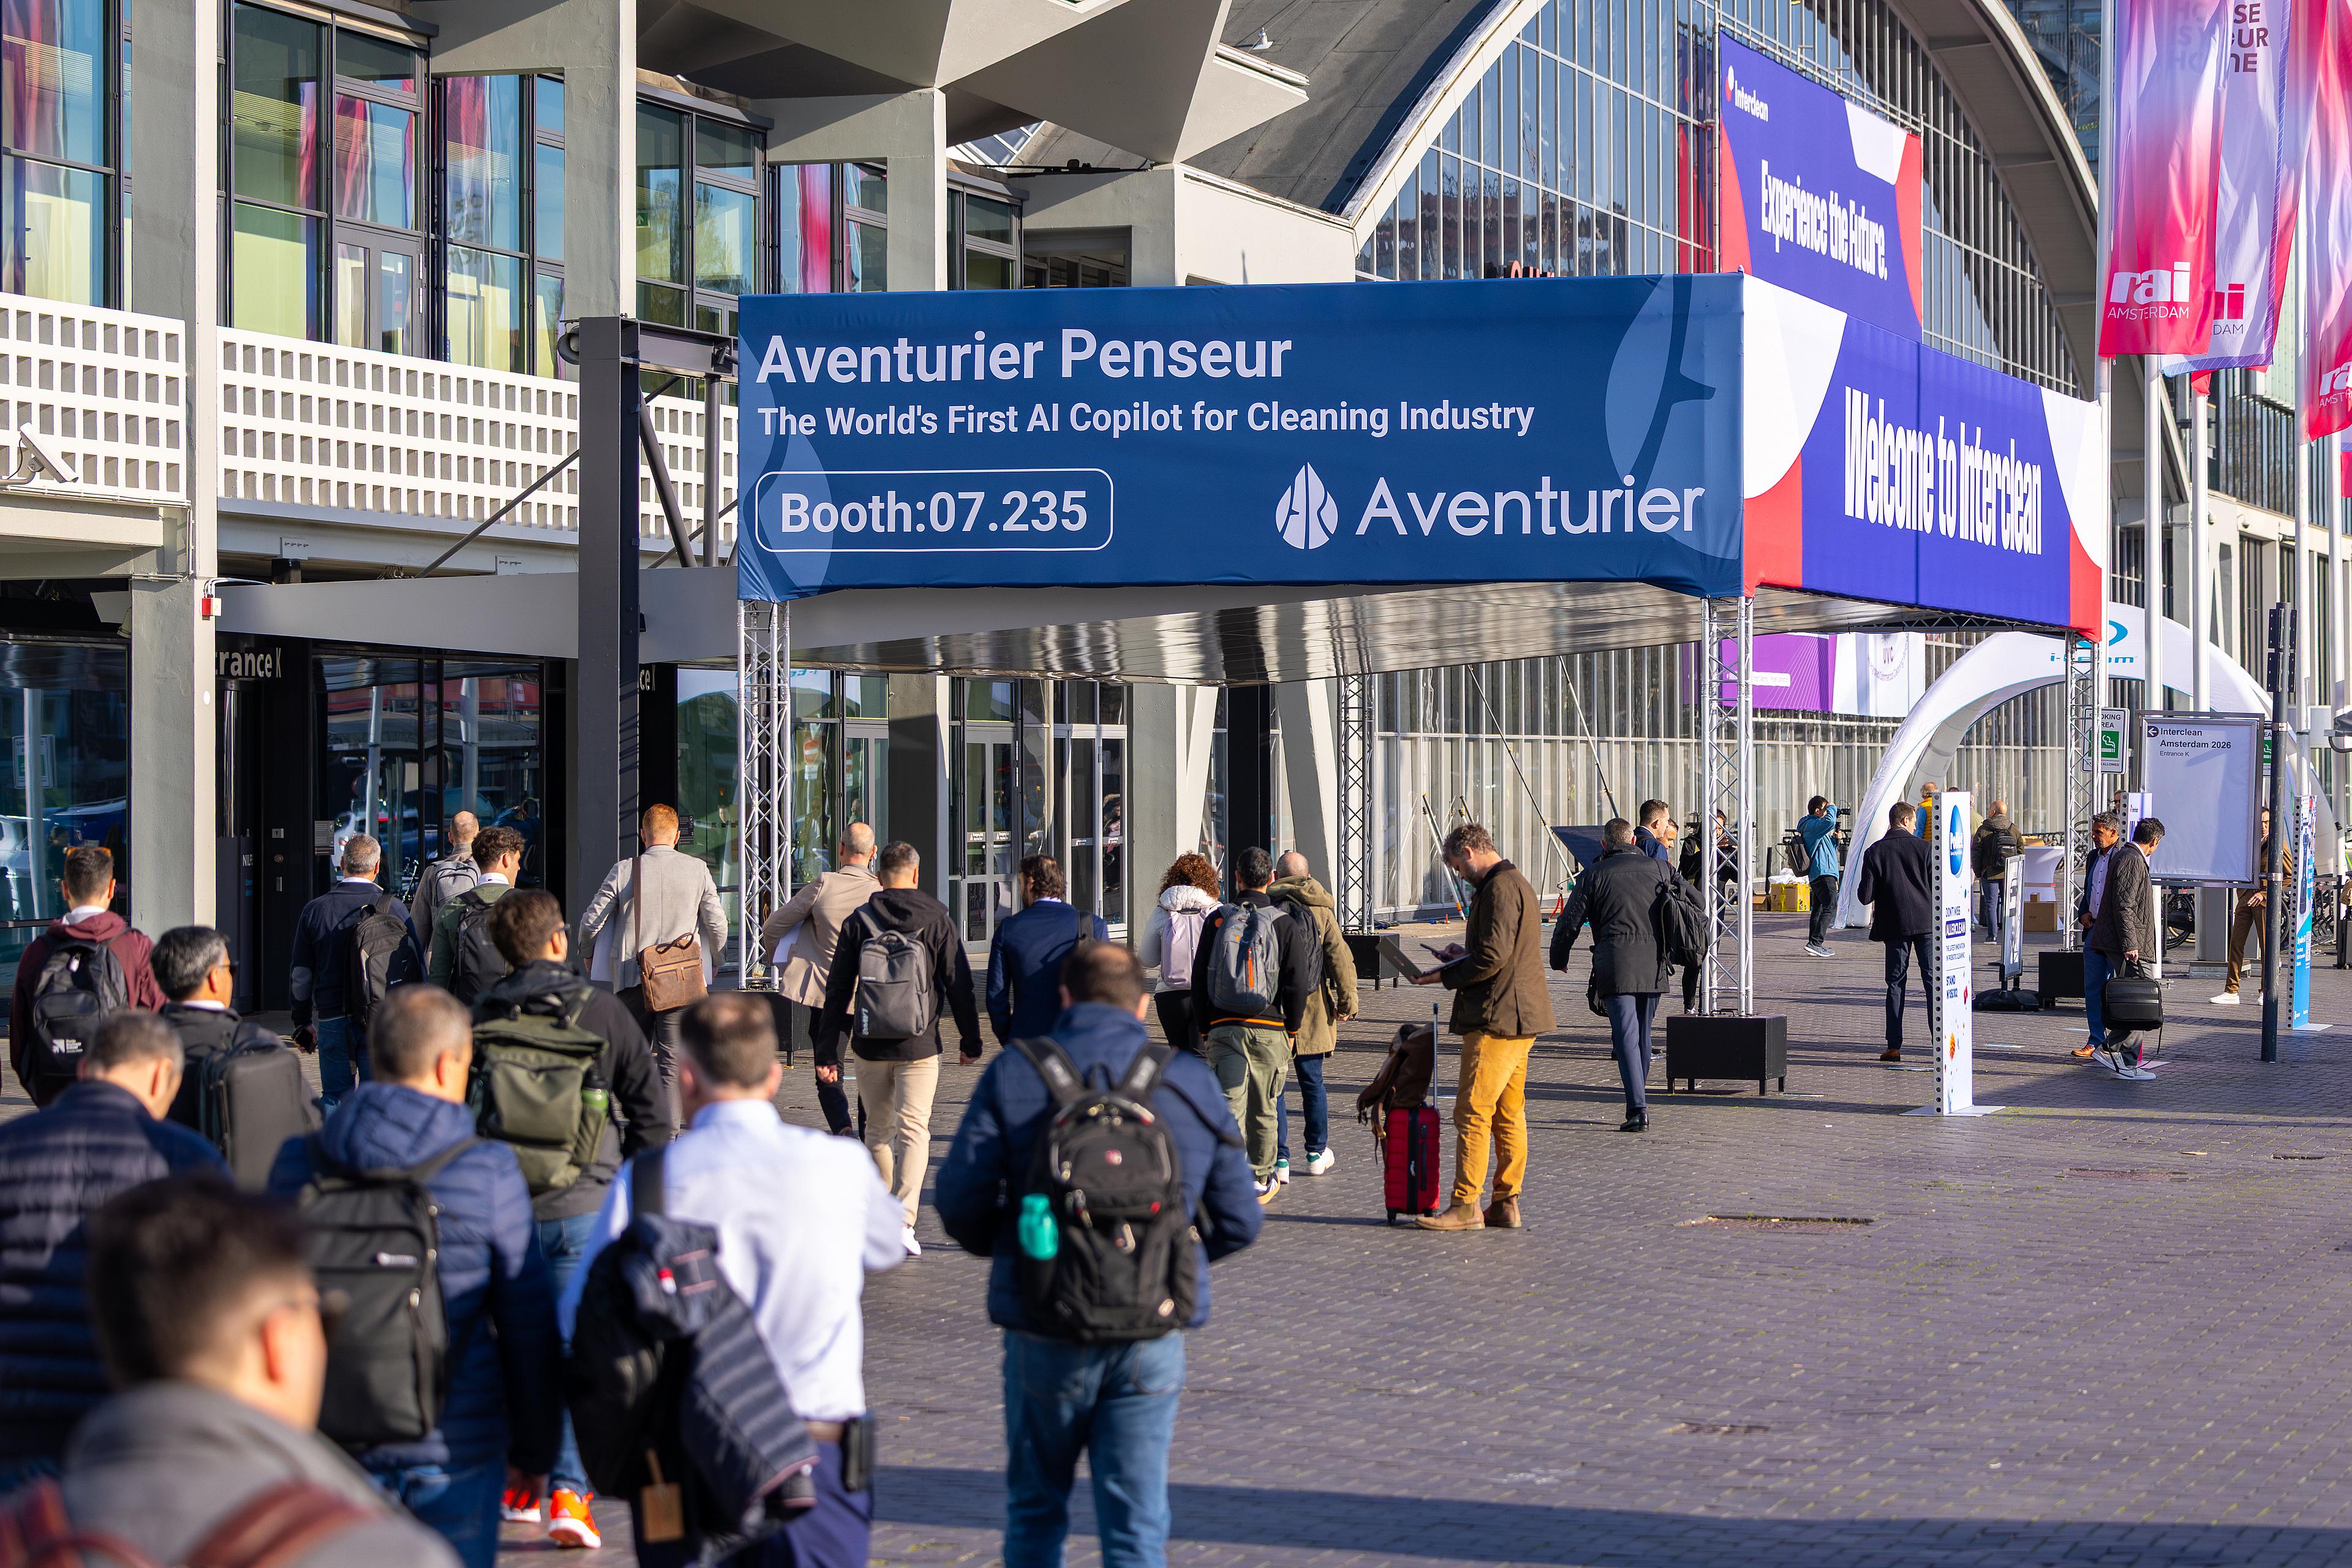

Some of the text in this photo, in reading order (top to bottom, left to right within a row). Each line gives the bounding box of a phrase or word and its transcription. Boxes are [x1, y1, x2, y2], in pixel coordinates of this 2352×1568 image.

[1735, 80, 1769, 122] Interclean
[1761, 159, 1888, 281] Experience the Future.
[2109, 262, 2191, 305] rai
[2108, 306, 2190, 320] AMSTERDAM
[756, 328, 1292, 383] Aventurier Penseur
[757, 399, 1535, 439] The World's First AI Copilot for Cleaning Industry
[1845, 386, 2041, 555] Welcome to Interclean
[782, 490, 1087, 533] Booth:07.235
[1355, 475, 1706, 537] Aventurier
[215, 647, 281, 678] rance K
[1883, 646, 1894, 665] UVC
[2160, 739, 2209, 748] Amsterdam
